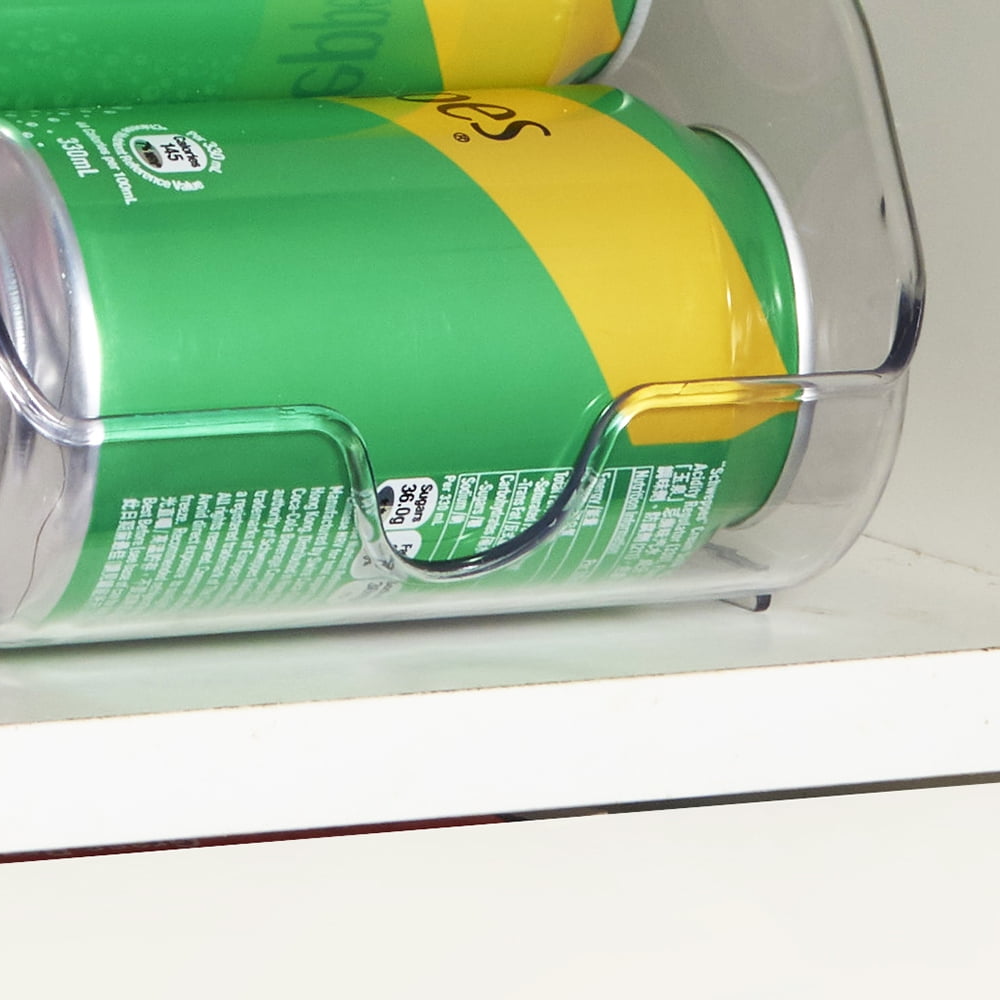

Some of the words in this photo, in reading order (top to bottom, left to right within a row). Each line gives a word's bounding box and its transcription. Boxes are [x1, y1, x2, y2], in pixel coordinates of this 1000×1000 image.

[56, 137, 100, 179] 330mL
[160, 143, 184, 163] 145
[202, 141, 226, 162] 330
[101, 155, 121, 172] per
[113, 172, 138, 206] 100mL
[441, 477, 456, 492] Per
[453, 477, 475, 511] Sodium
[137, 495, 158, 517] Best
[193, 492, 213, 518] Avoid
[280, 487, 306, 532] Coca-Cola
[389, 482, 417, 525] 36.0g
[410, 482, 432, 522] Sugars
[436, 492, 452, 511] 330
